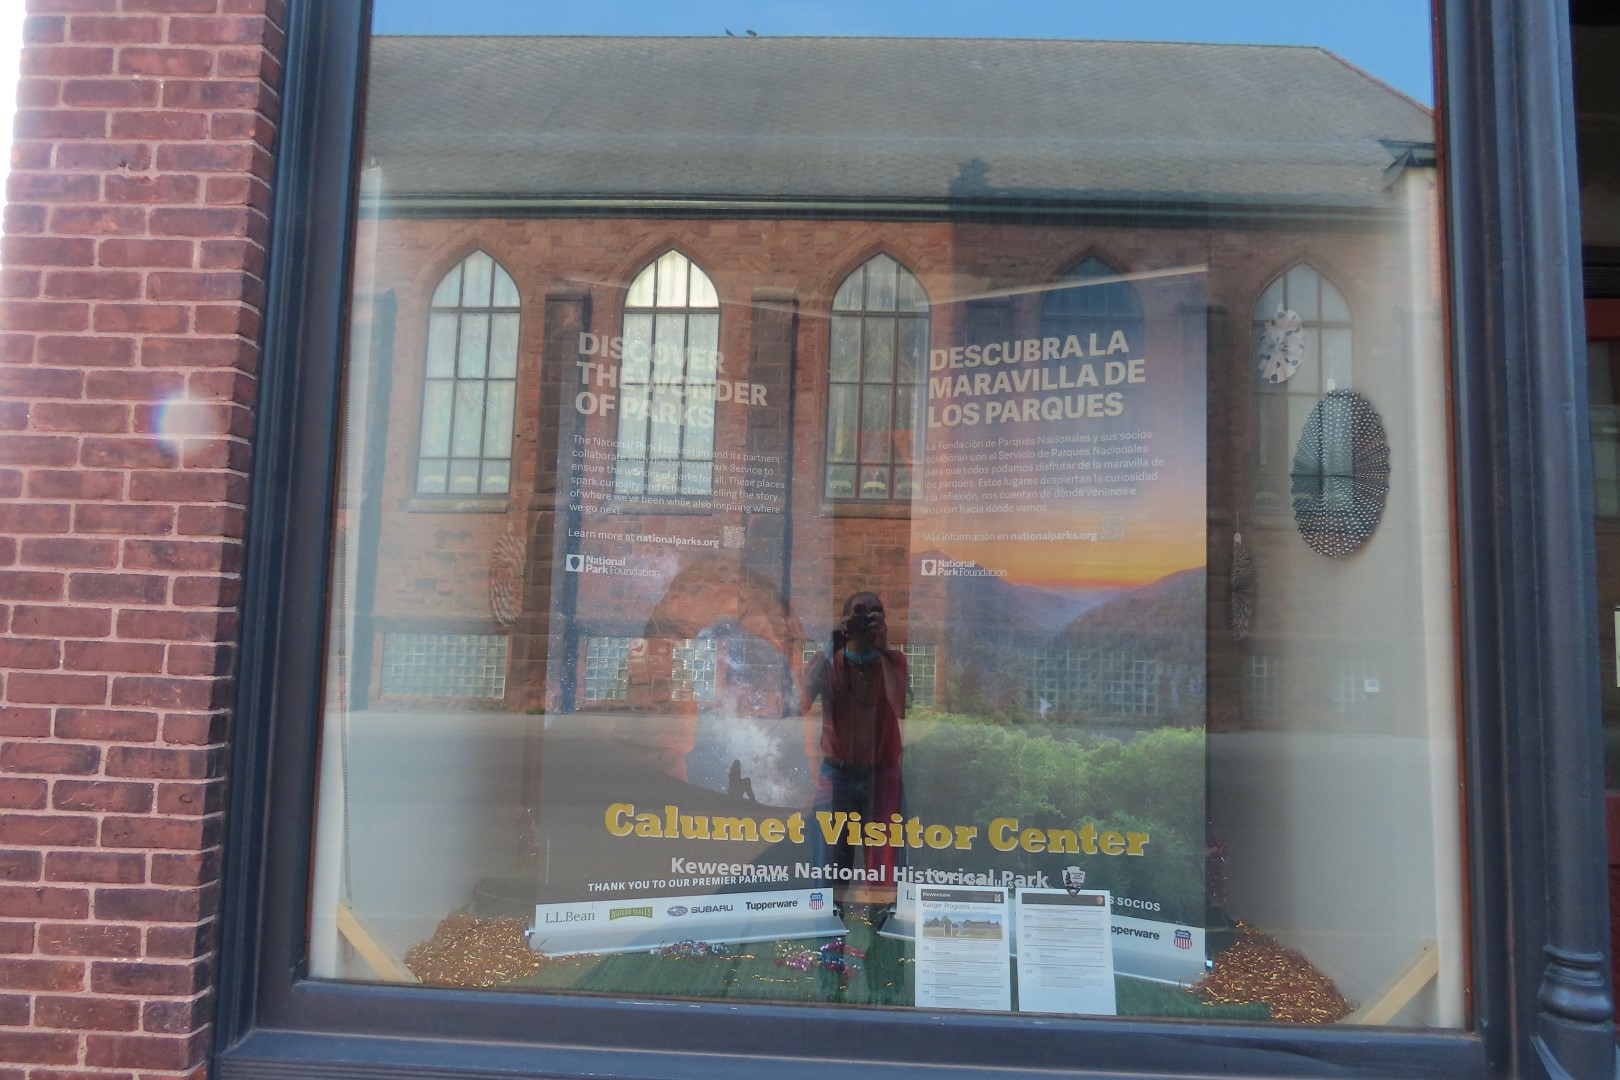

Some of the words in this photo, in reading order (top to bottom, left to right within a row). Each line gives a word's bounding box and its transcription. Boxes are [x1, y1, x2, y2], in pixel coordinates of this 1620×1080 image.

[578, 332, 725, 373] DISCOVER
[930, 335, 1084, 372] DESCUBRA
[1090, 330, 1130, 357] LA
[576, 361, 635, 390] THE
[642, 371, 768, 407] WONDER
[928, 363, 1099, 400] MARAVILLA
[1104, 359, 1146, 386] DE
[575, 392, 616, 416] OF
[621, 396, 715, 429] PARKS
[928, 402, 980, 428] LOS
[985, 391, 1124, 425] PARQUES
[573, 434, 591, 445] The
[593, 437, 633, 449] National
[635, 441, 656, 452] Park
[658, 444, 710, 457] Foundation
[712, 451, 728, 459] and
[730, 451, 741, 460] its
[744, 453, 780, 464] partners
[926, 443, 936, 451] La
[938, 440, 984, 450] Fundación
[985, 440, 996, 448] de
[998, 437, 1036, 447] Parques
[1037, 434, 1091, 445] Nacionales
[1101, 433, 1118, 442] sus
[1119, 431, 1153, 440] socios
[572, 449, 627, 462] collaborate
[628, 454, 648, 464] with
[651, 456, 665, 465] the
[668, 458, 706, 469] National
[708, 461, 728, 471] Park
[730, 463, 762, 474] Service
[764, 467, 774, 476] to
[925, 452, 968, 463] colaboran
[969, 454, 987, 462] con
[988, 451, 997, 460] el
[998, 449, 1036, 460] Servicio
[1037, 449, 1049, 458] de
[1051, 448, 1090, 458] Parques
[1092, 444, 1149, 455] Nacionales
[571, 464, 605, 473] ensure
[606, 466, 622, 475] the
[624, 467, 659, 479] wonder
[661, 470, 670, 479] of
[672, 472, 698, 483] parks
[699, 473, 712, 482] for
[713, 476, 727, 485] all.
[729, 477, 755, 487] These
[756, 479, 785, 489] places
[945, 467, 961, 476] que
[963, 465, 989, 474] todos
[991, 463, 1034, 475] podamos
[1035, 461, 1075, 472] disfrutar
[1077, 460, 1090, 470] de
[1092, 460, 1102, 469] la
[1103, 457, 1149, 469] maravilla
[1151, 457, 1165, 467] de
[570, 476, 598, 486] spark
[600, 478, 641, 491] curiosity
[643, 482, 660, 491] and
[710, 488, 737, 499] telling
[739, 489, 754, 499] the
[756, 491, 778, 502] story
[924, 481, 937, 489] los
[978, 478, 1002, 487] Estos
[1004, 477, 1038, 488] lugares
[1040, 474, 1091, 486] despiertan
[1093, 474, 1103, 483] la
[1104, 471, 1158, 483] curiosidad
[570, 489, 581, 498] of
[581, 490, 611, 500] where
[613, 494, 639, 503] we've
[641, 495, 665, 505] been
[666, 497, 691, 508] while
[693, 499, 711, 509] also
[713, 501, 752, 513] inspiring
[753, 504, 781, 514] where
[981, 492, 998, 500] nos
[999, 490, 1038, 500] cuentan
[1040, 489, 1051, 498] de
[1086, 487, 1129, 497] venimos
[1130, 488, 1137, 496] e
[569, 503, 583, 512] we
[585, 505, 597, 514] go
[600, 506, 623, 515] next.
[959, 504, 984, 514] hacia
[985, 503, 1014, 513] dónde
[568, 528, 596, 539] Learn
[598, 532, 623, 541] more
[624, 533, 634, 541] at
[636, 534, 720, 549] nationalparks.org
[1010, 531, 1098, 543] nationalparks.org
[585, 555, 626, 566] National
[938, 559, 975, 568] National
[585, 565, 608, 574] Park
[609, 565, 661, 577] Foundation
[937, 567, 958, 577] Park
[959, 567, 1008, 577] Foundation
[604, 802, 805, 844] Calumet
[815, 811, 978, 850] Visitor
[988, 817, 1150, 856] Center
[588, 881, 626, 892] THANK
[627, 880, 650, 889] YOU
[652, 879, 666, 889] TO
[668, 878, 690, 888] OUR
[692, 876, 737, 887] PREMIER
[738, 873, 789, 884] PARTNERS
[671, 857, 789, 877] Keweenaw
[794, 862, 886, 882] National
[893, 865, 994, 887] Historical
[1001, 868, 1050, 889] Park
[545, 910, 596, 924] L.L.Bean
[690, 904, 734, 914] SUBARU
[745, 899, 798, 911] Tupperware
[1116, 897, 1161, 912] SOCIOS
[1111, 924, 1160, 940] pperware
